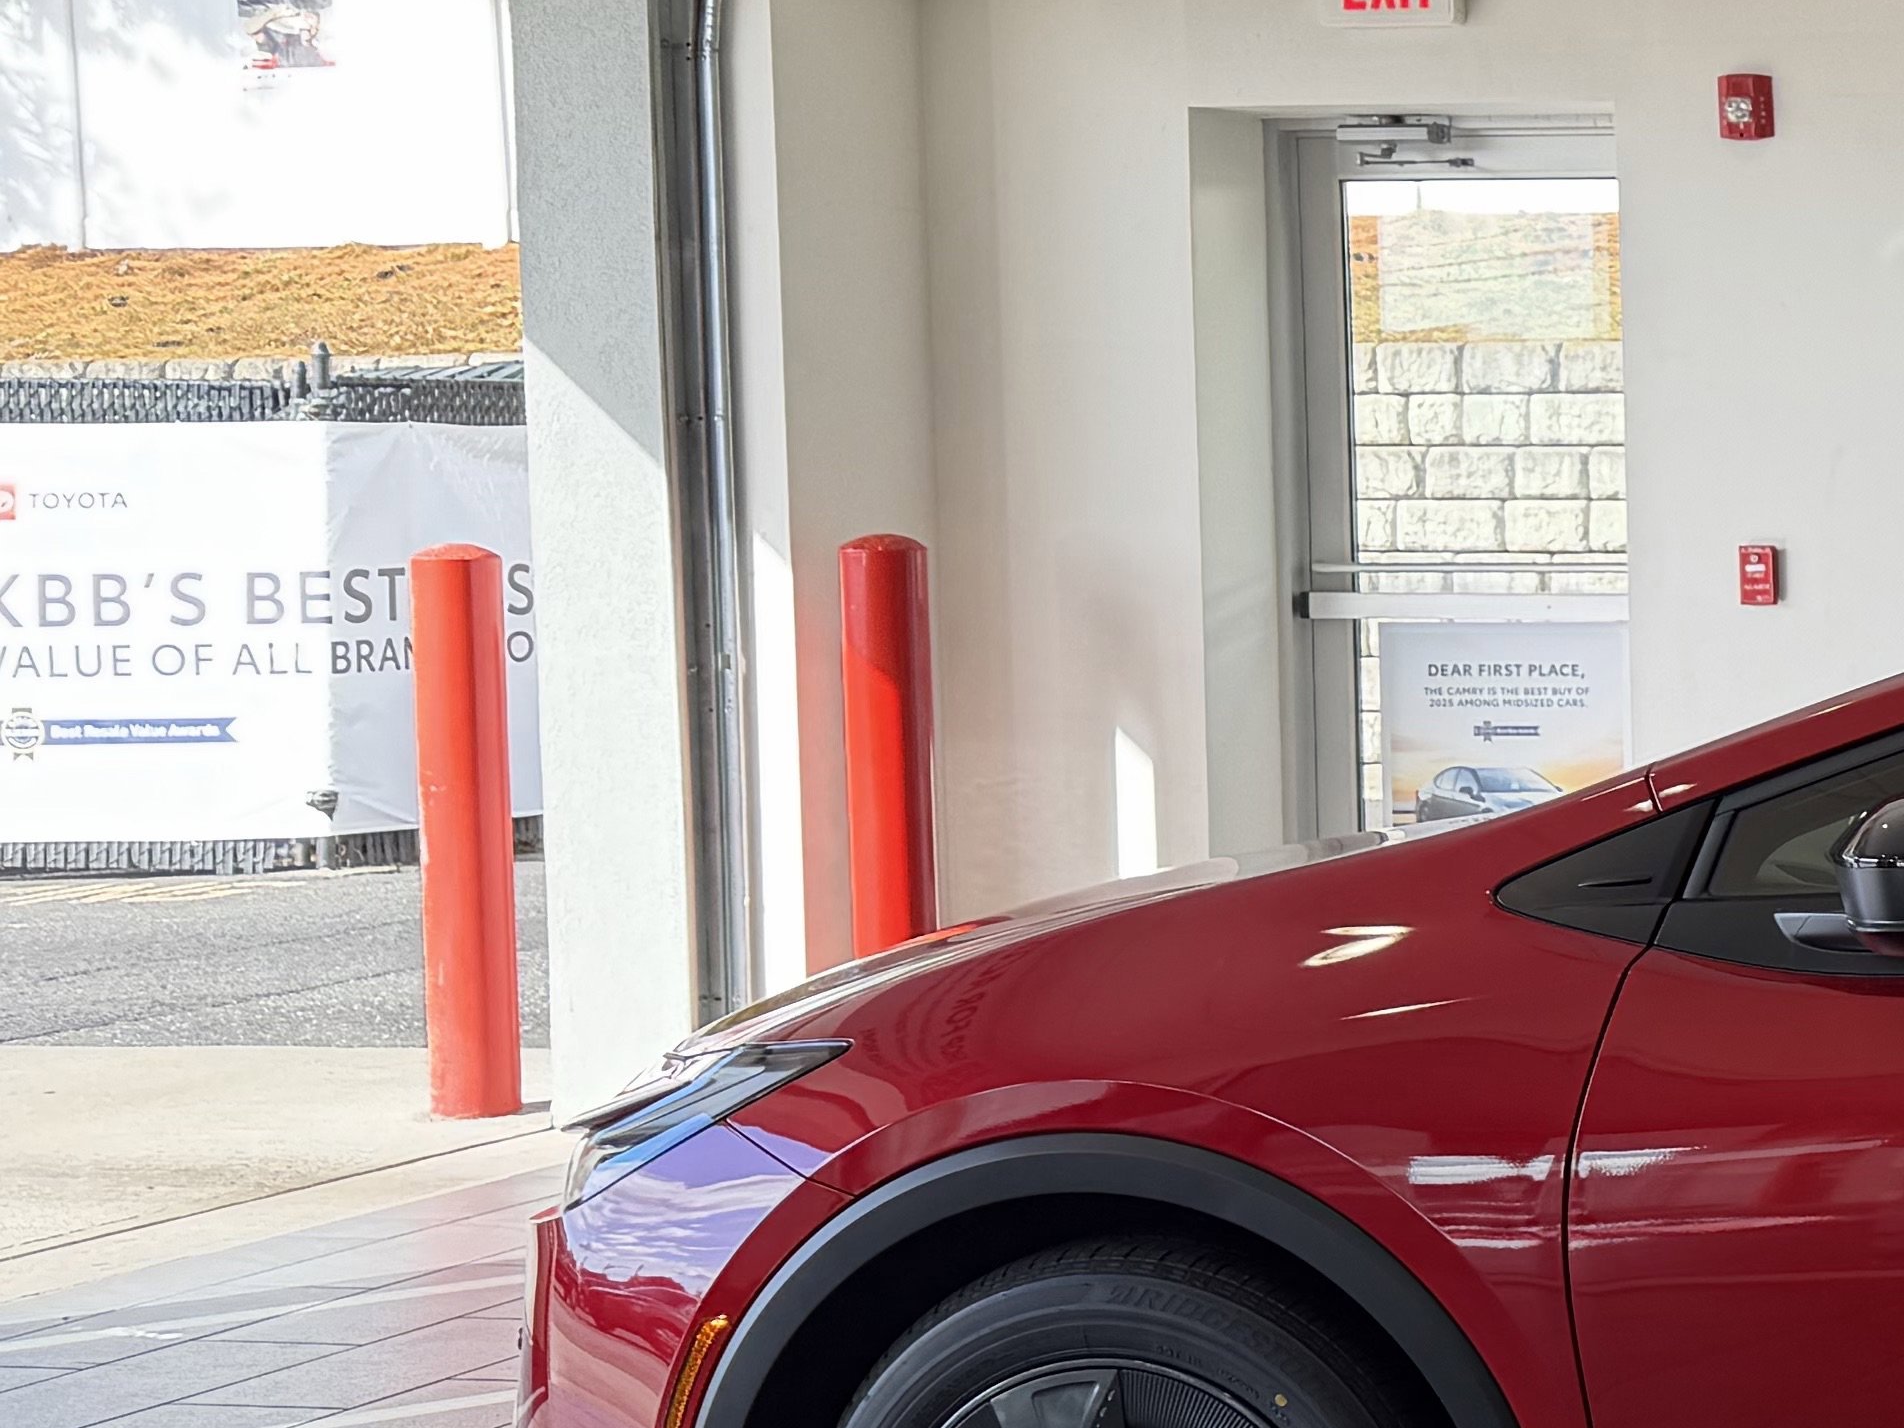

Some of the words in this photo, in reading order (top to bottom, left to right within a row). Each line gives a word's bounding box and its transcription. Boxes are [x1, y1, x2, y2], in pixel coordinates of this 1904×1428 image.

[29, 492, 128, 509] TOYOTA
[247, 567, 406, 625] BEST
[152, 643, 213, 676] OF
[234, 643, 313, 675] ALL
[1428, 664, 1472, 677] DEAR
[1478, 664, 1523, 677] FIRST
[1528, 664, 1585, 679] PLACE,
[1424, 687, 1443, 696] THE
[1447, 687, 1484, 696] CAMRY
[1488, 687, 1497, 696] IS
[1501, 687, 1519, 696] THE
[1524, 687, 1548, 696] BEST
[1552, 687, 1572, 696] BUY
[1576, 687, 1589, 696] OF
[1457, 699, 1500, 707] AMONG
[1503, 699, 1554, 707] MIDSIZED
